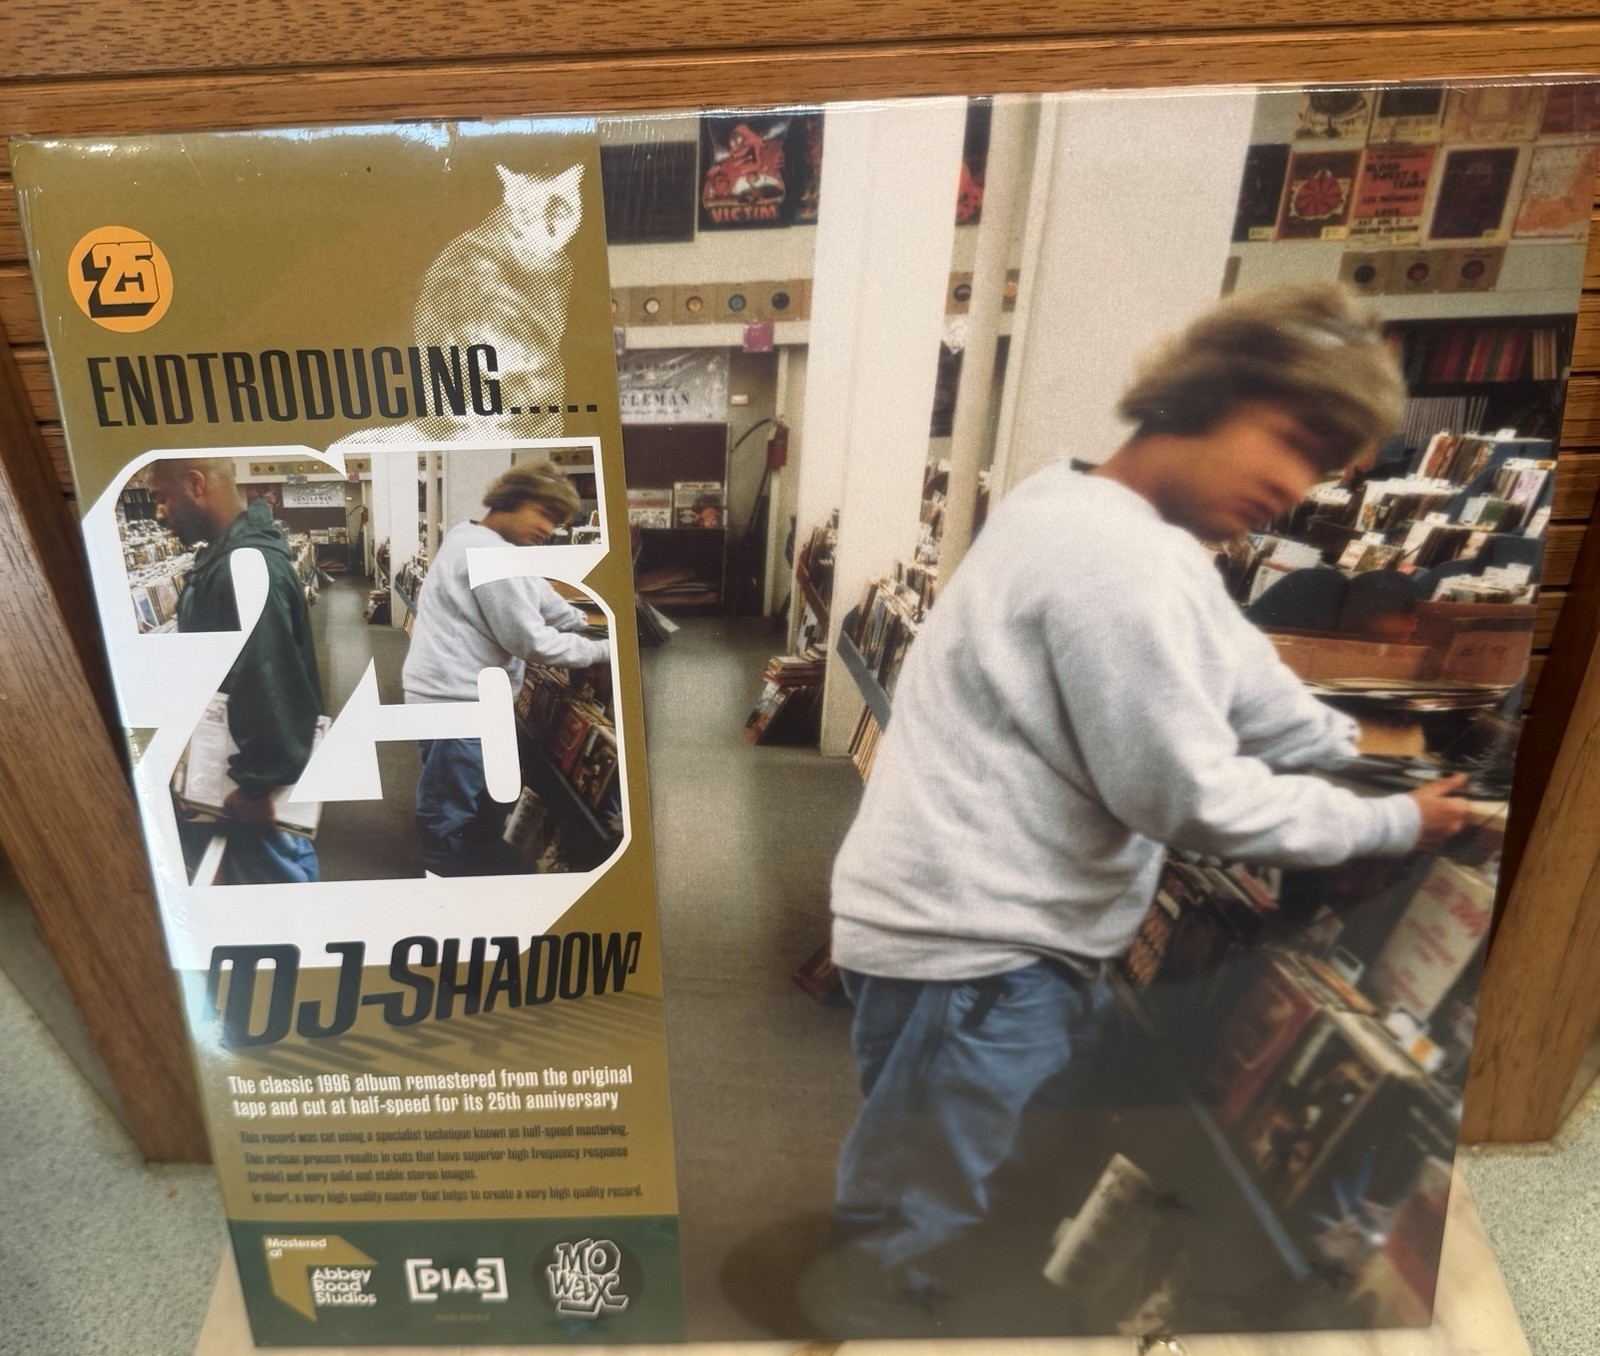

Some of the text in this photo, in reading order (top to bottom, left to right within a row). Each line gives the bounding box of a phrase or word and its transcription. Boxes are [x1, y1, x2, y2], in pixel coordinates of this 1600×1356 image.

[710, 204, 777, 225] VICTIM
[82, 241, 160, 319] 25
[206, 930, 643, 1049] DJ-SHADOW
[228, 1065, 632, 1094] The classic 1996 album remastered from the original
[233, 1090, 619, 1119] tape and cut at half-speed for its 25th anniversary
[240, 1131, 261, 1143] This
[262, 1131, 296, 1143] record
[297, 1132, 319, 1143] was
[320, 1131, 336, 1143] cut
[338, 1131, 365, 1144] using
[367, 1132, 374, 1142] a
[375, 1129, 422, 1143] specialist
[424, 1127, 472, 1141] technique
[473, 1126, 507, 1139] known
[508, 1127, 520, 1138] as
[522, 1124, 574, 1139] half-speed
[245, 1145, 629, 1166] This artisan process results in cuts that have superior high frequency response
[286, 1170, 304, 1182] and
[305, 1172, 328, 1184] very
[330, 1170, 354, 1182] solid
[355, 1169, 373, 1181] and
[375, 1168, 405, 1181] stable
[407, 1169, 439, 1181] stereo
[302, 1192, 326, 1205] very
[327, 1190, 349, 1204] high
[350, 1190, 382, 1204] quality
[384, 1190, 417, 1202] master
[421, 1189, 441, 1201] that
[442, 1188, 469, 1202] helps
[470, 1188, 481, 1200] to
[482, 1188, 515, 1201] create
[516, 1190, 523, 1200] a
[525, 1188, 548, 1201] very
[549, 1185, 571, 1200] high
[573, 1185, 605, 1200] quality
[267, 1237, 327, 1249] Mastered
[311, 1267, 372, 1284] Abbey
[313, 1278, 363, 1294] Road
[314, 1290, 378, 1308] Studios
